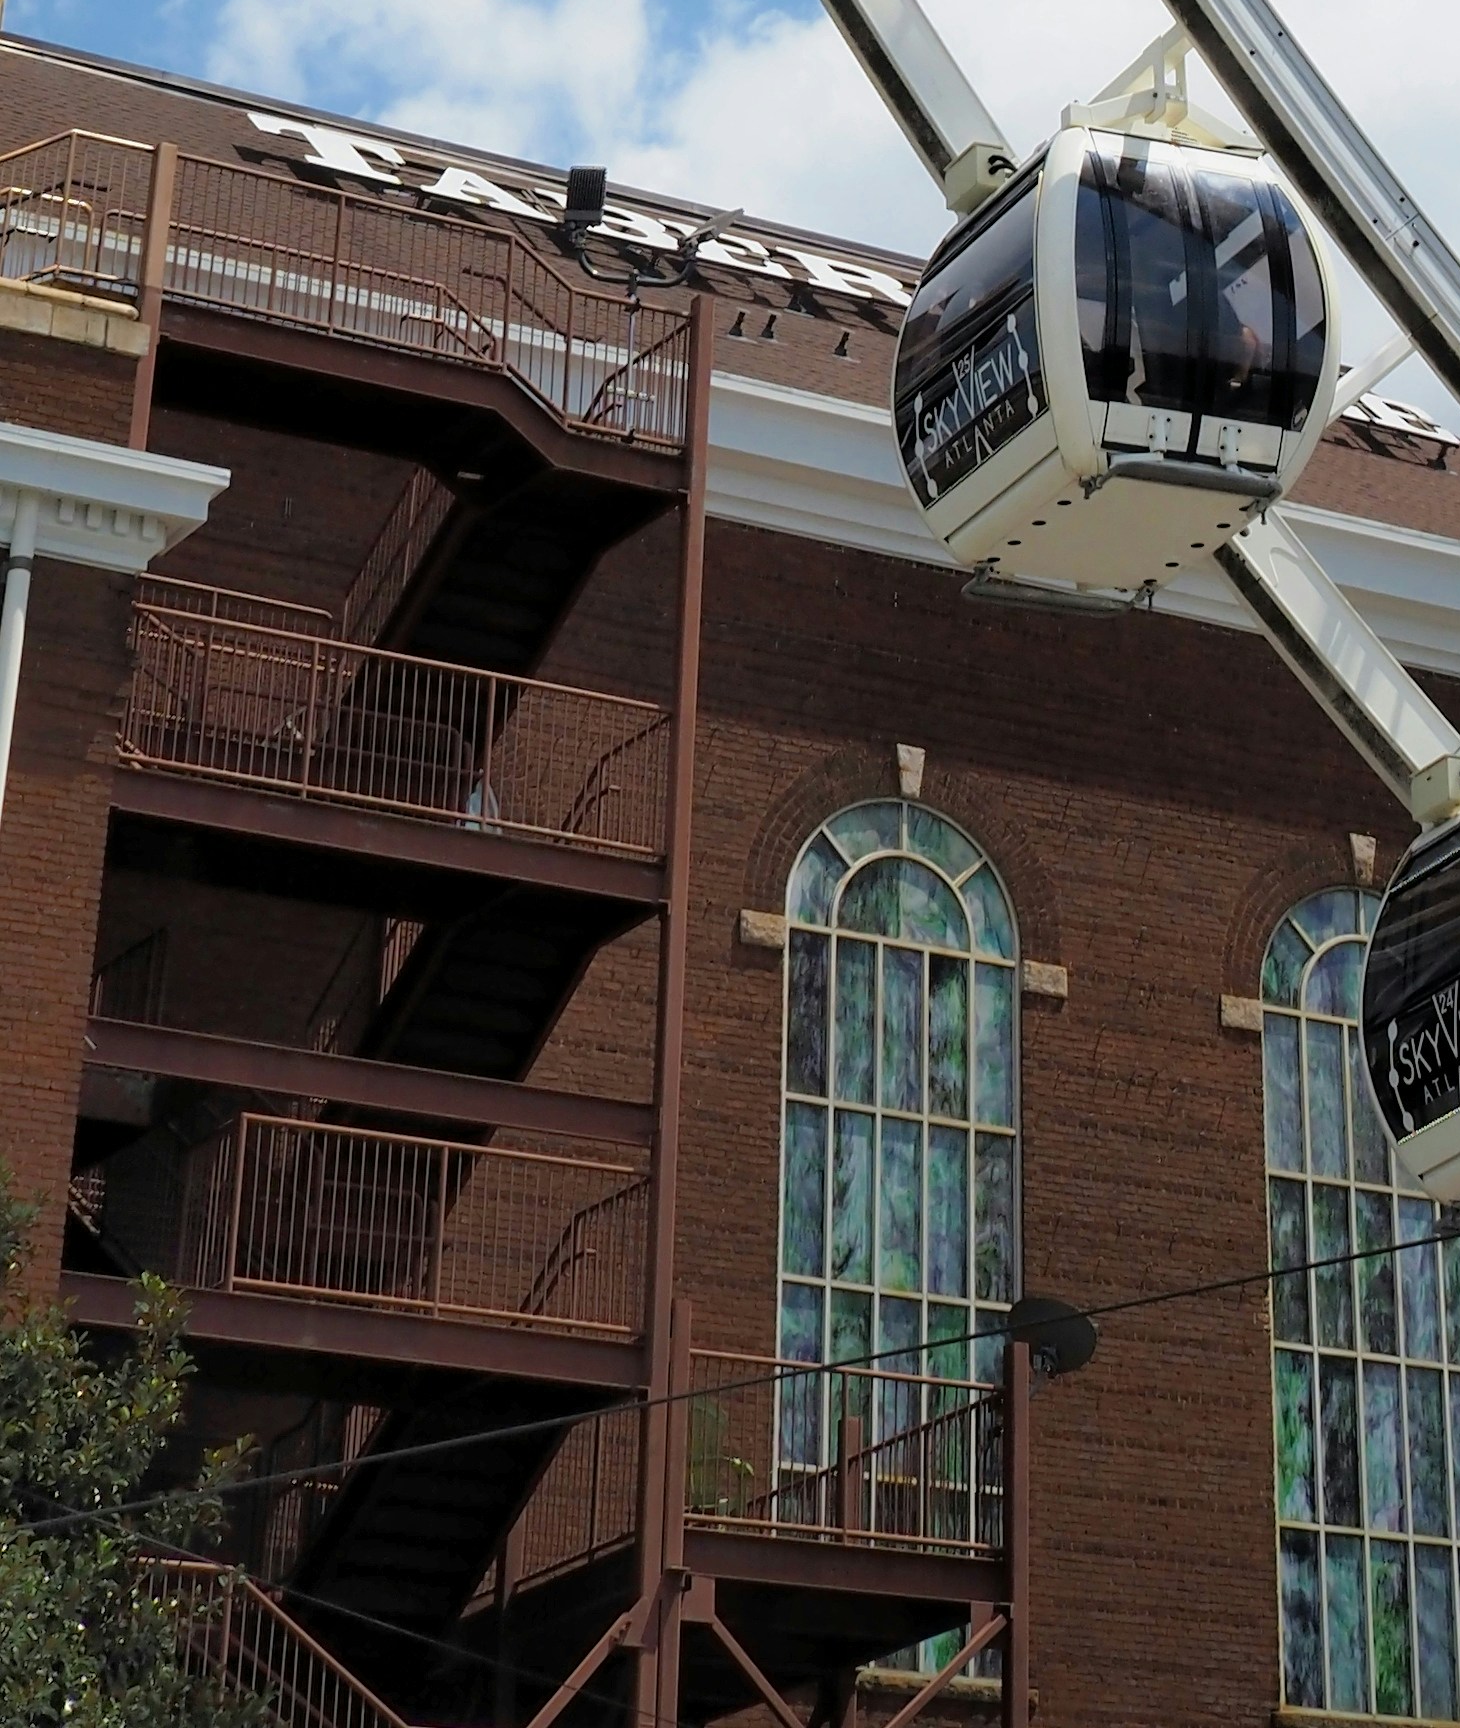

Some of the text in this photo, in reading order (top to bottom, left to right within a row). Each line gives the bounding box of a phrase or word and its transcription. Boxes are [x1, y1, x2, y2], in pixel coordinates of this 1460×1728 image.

[957, 353, 971, 380] 25
[924, 345, 1014, 453] SKYVIEW
[944, 399, 1015, 468] ATLANTA
[1439, 990, 1454, 1015] 24
